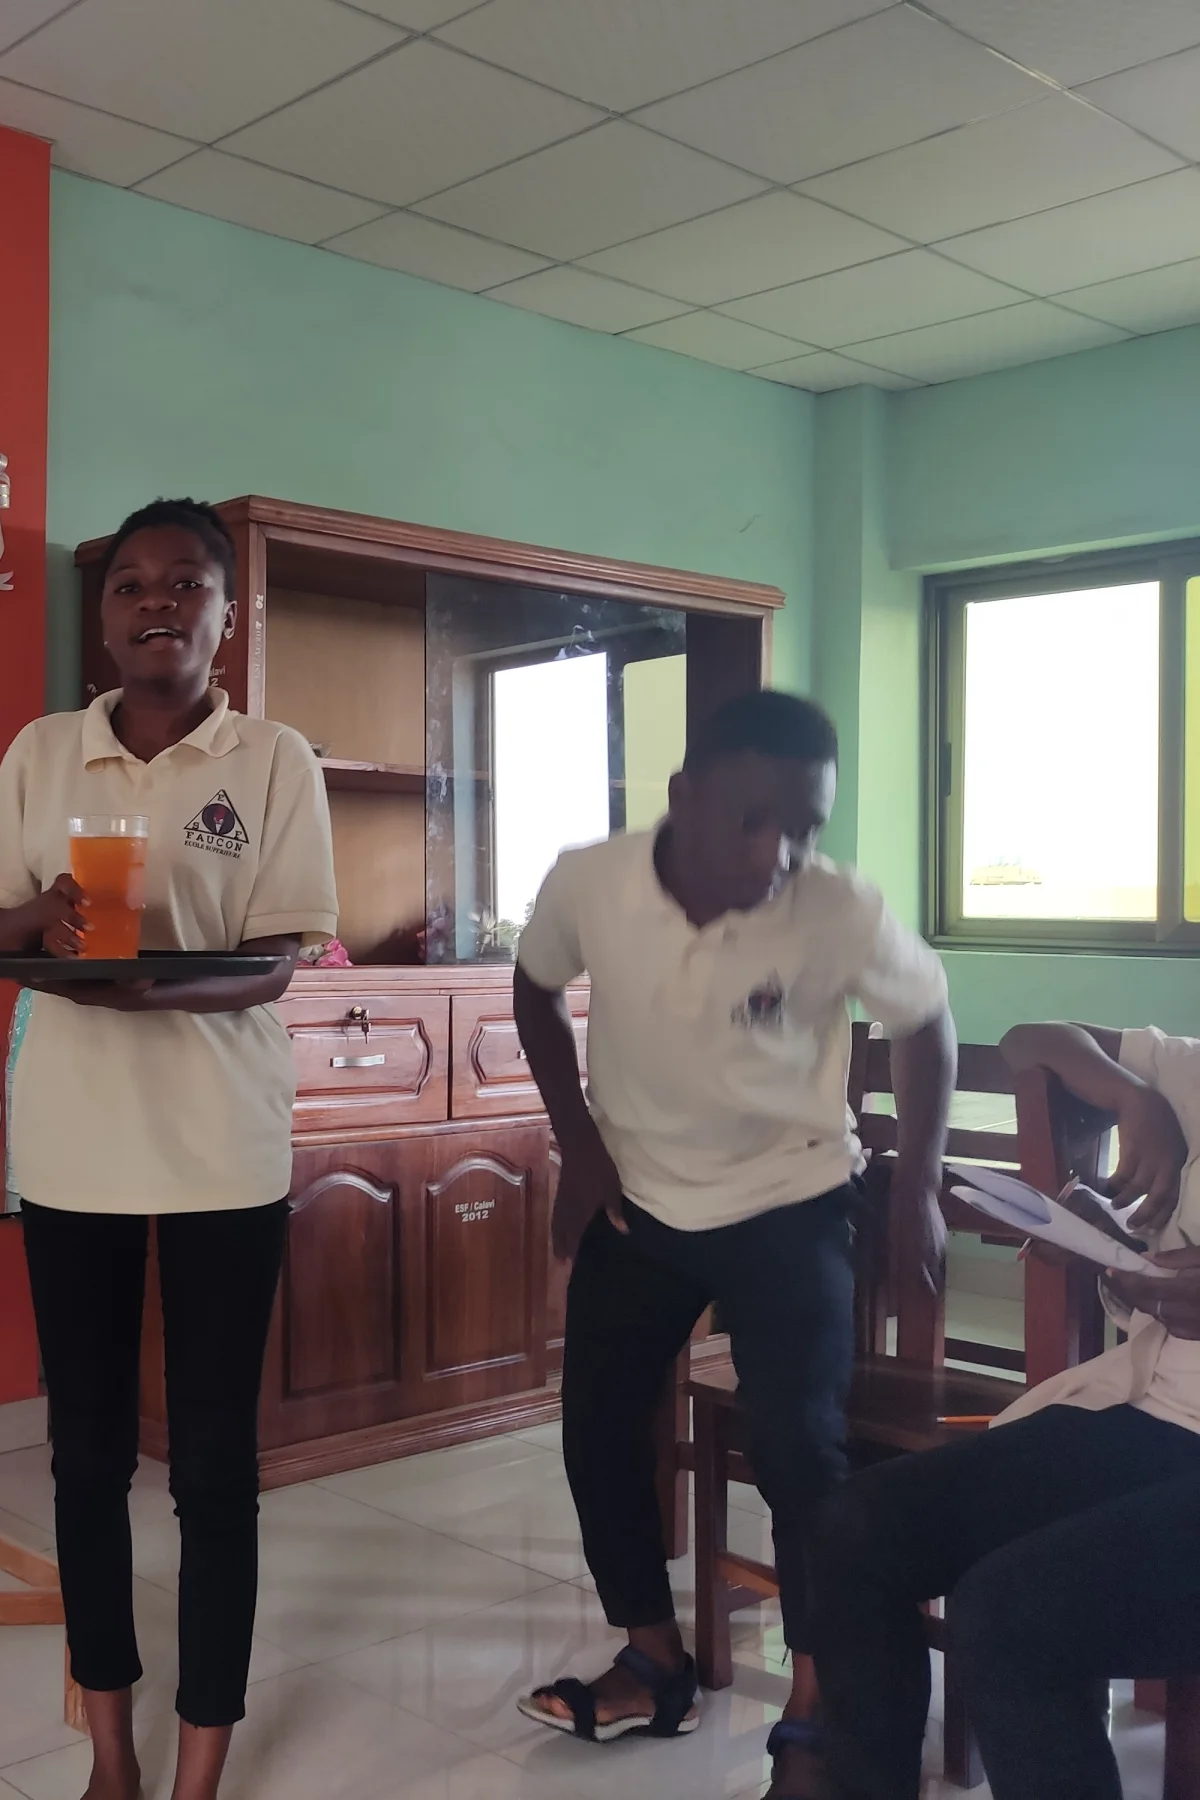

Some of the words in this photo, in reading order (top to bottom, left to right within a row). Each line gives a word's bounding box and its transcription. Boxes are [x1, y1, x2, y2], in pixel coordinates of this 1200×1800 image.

[184, 840, 205, 850] ECOLE
[185, 830, 243, 852] FAUCON
[454, 1202, 469, 1214] ESF
[473, 1198, 496, 1211] Calavi
[461, 1210, 489, 1222] 2012
